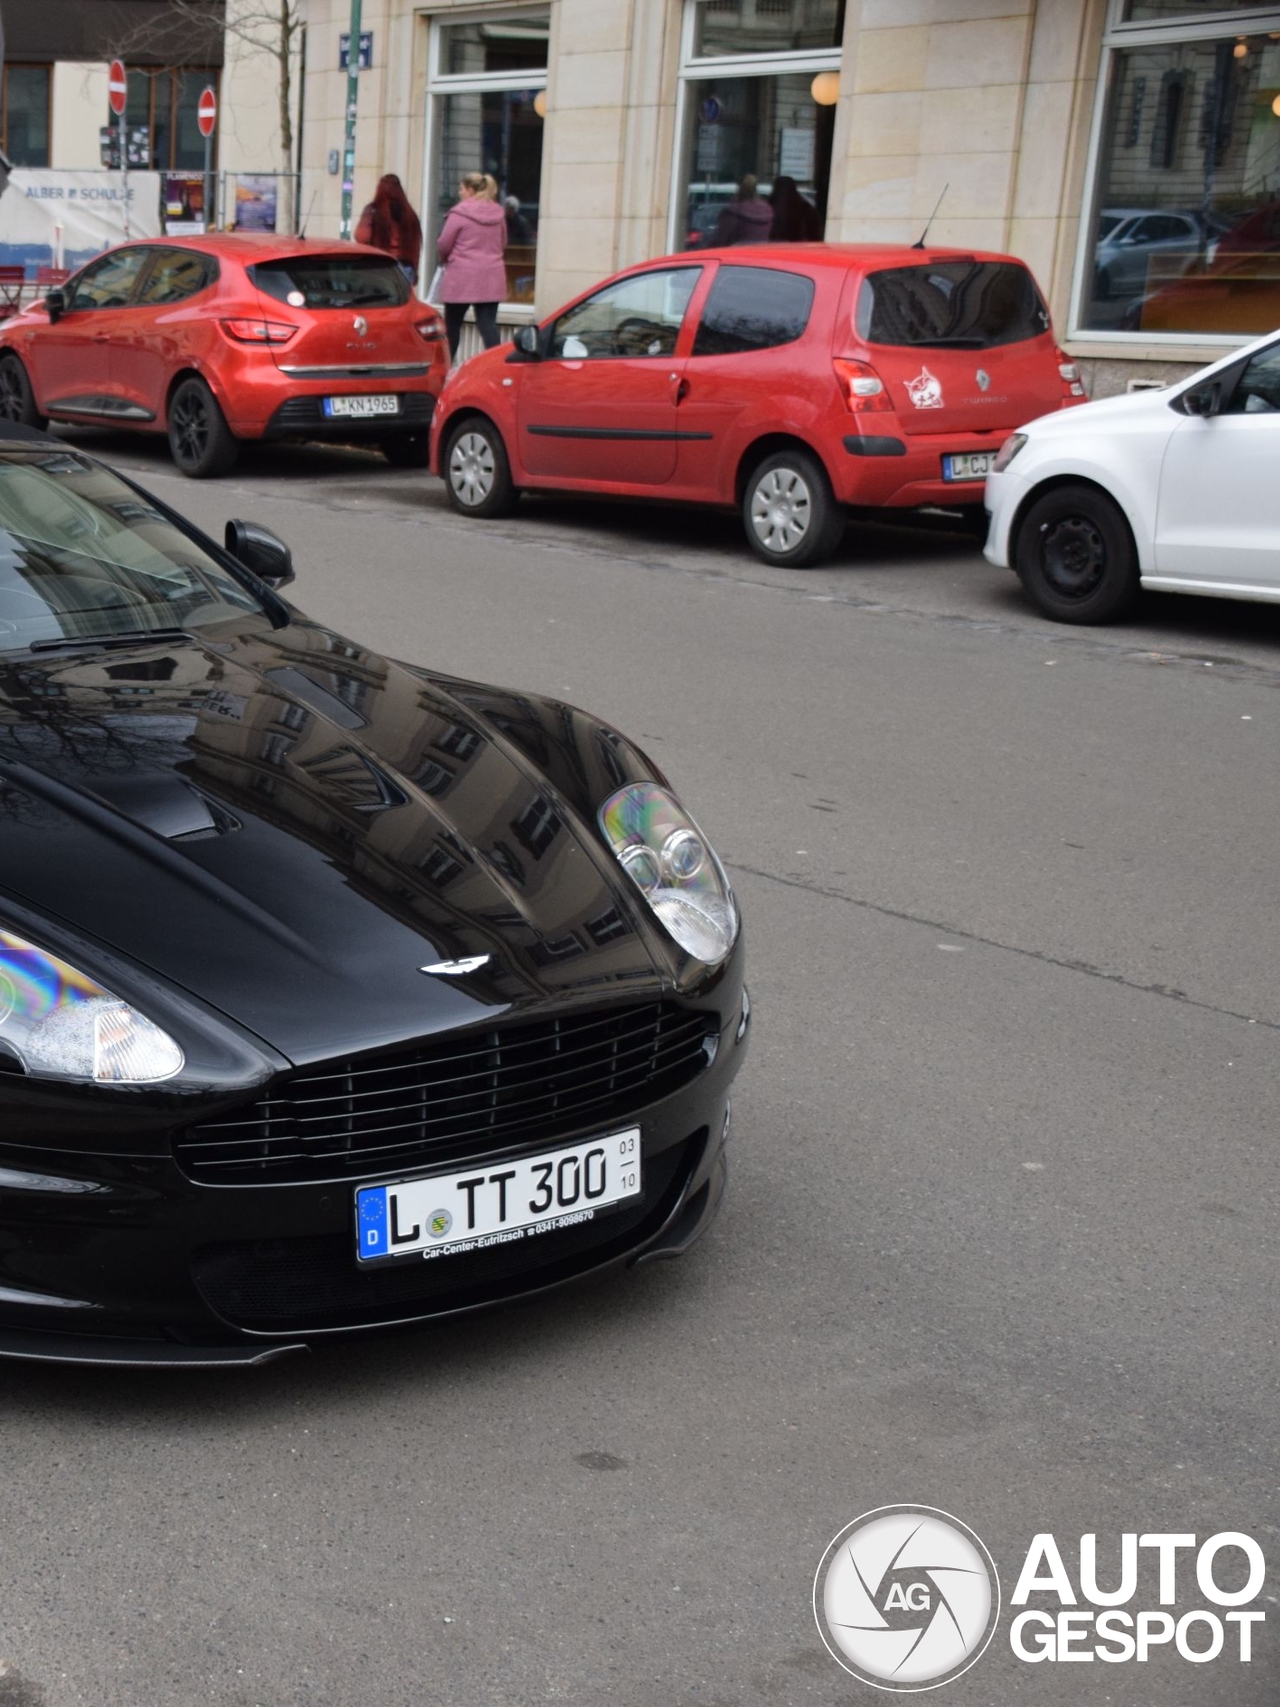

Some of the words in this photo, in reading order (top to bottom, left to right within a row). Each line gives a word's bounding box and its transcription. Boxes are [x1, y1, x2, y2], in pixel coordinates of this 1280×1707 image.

[25, 187, 64, 199] ALBER
[331, 398, 341, 413] L
[348, 398, 364, 412] KN
[367, 397, 396, 412] 1965
[961, 396, 1008, 404] TWINGO
[952, 457, 961, 475] L
[970, 456, 988, 473] CJ
[619, 1138, 635, 1155] 03
[620, 1173, 636, 1189] 10
[368, 1230, 378, 1246] D
[389, 1194, 420, 1246] L
[456, 1170, 516, 1230] TT
[529, 1148, 606, 1214] 300
[422, 1229, 524, 1259] Car-Center-Eutritzsch
